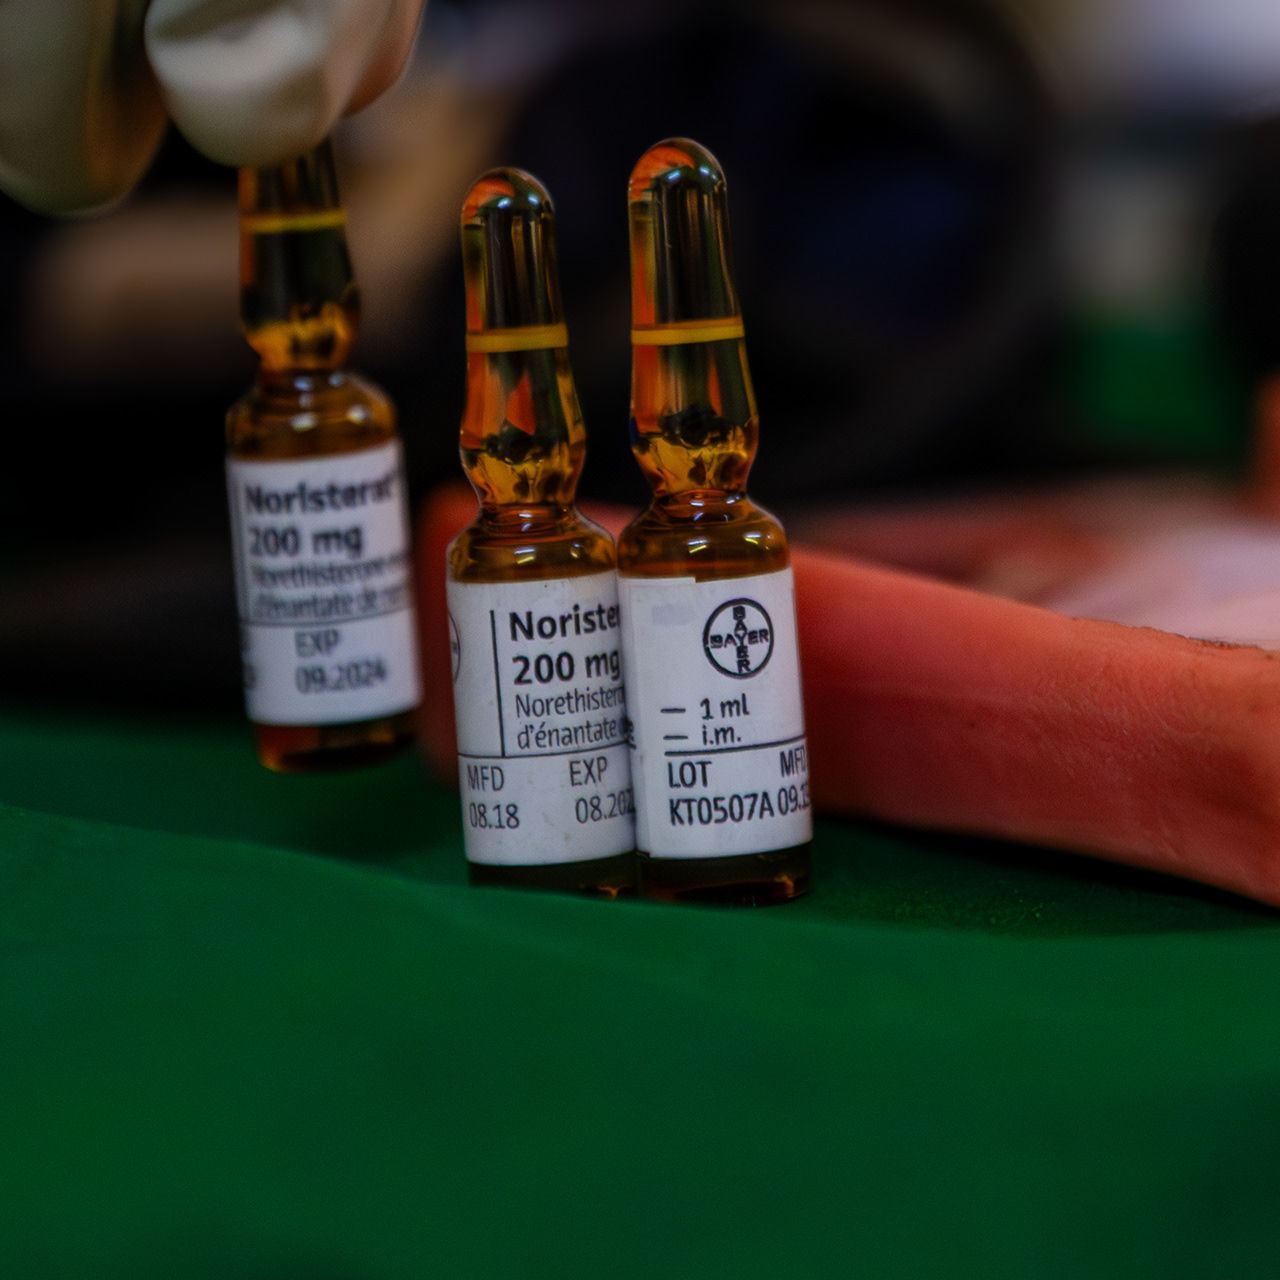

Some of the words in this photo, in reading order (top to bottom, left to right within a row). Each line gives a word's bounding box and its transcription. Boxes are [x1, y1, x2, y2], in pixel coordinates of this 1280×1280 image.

[249, 526, 300, 558] 200
[312, 525, 363, 559] mg
[295, 629, 340, 657] EXP
[709, 629, 770, 649] BAYER
[732, 606, 751, 674] BAYER
[295, 658, 386, 693] 09.2024
[512, 652, 575, 686] 200
[585, 649, 622, 682] mg
[699, 698, 714, 720] 1
[720, 693, 750, 717] ml
[702, 725, 742, 746] i.m.
[466, 765, 505, 792] MFD
[569, 757, 608, 787] EXP
[668, 760, 712, 789] LOT
[468, 803, 520, 830] 08.18
[669, 791, 775, 826] KT0507A
